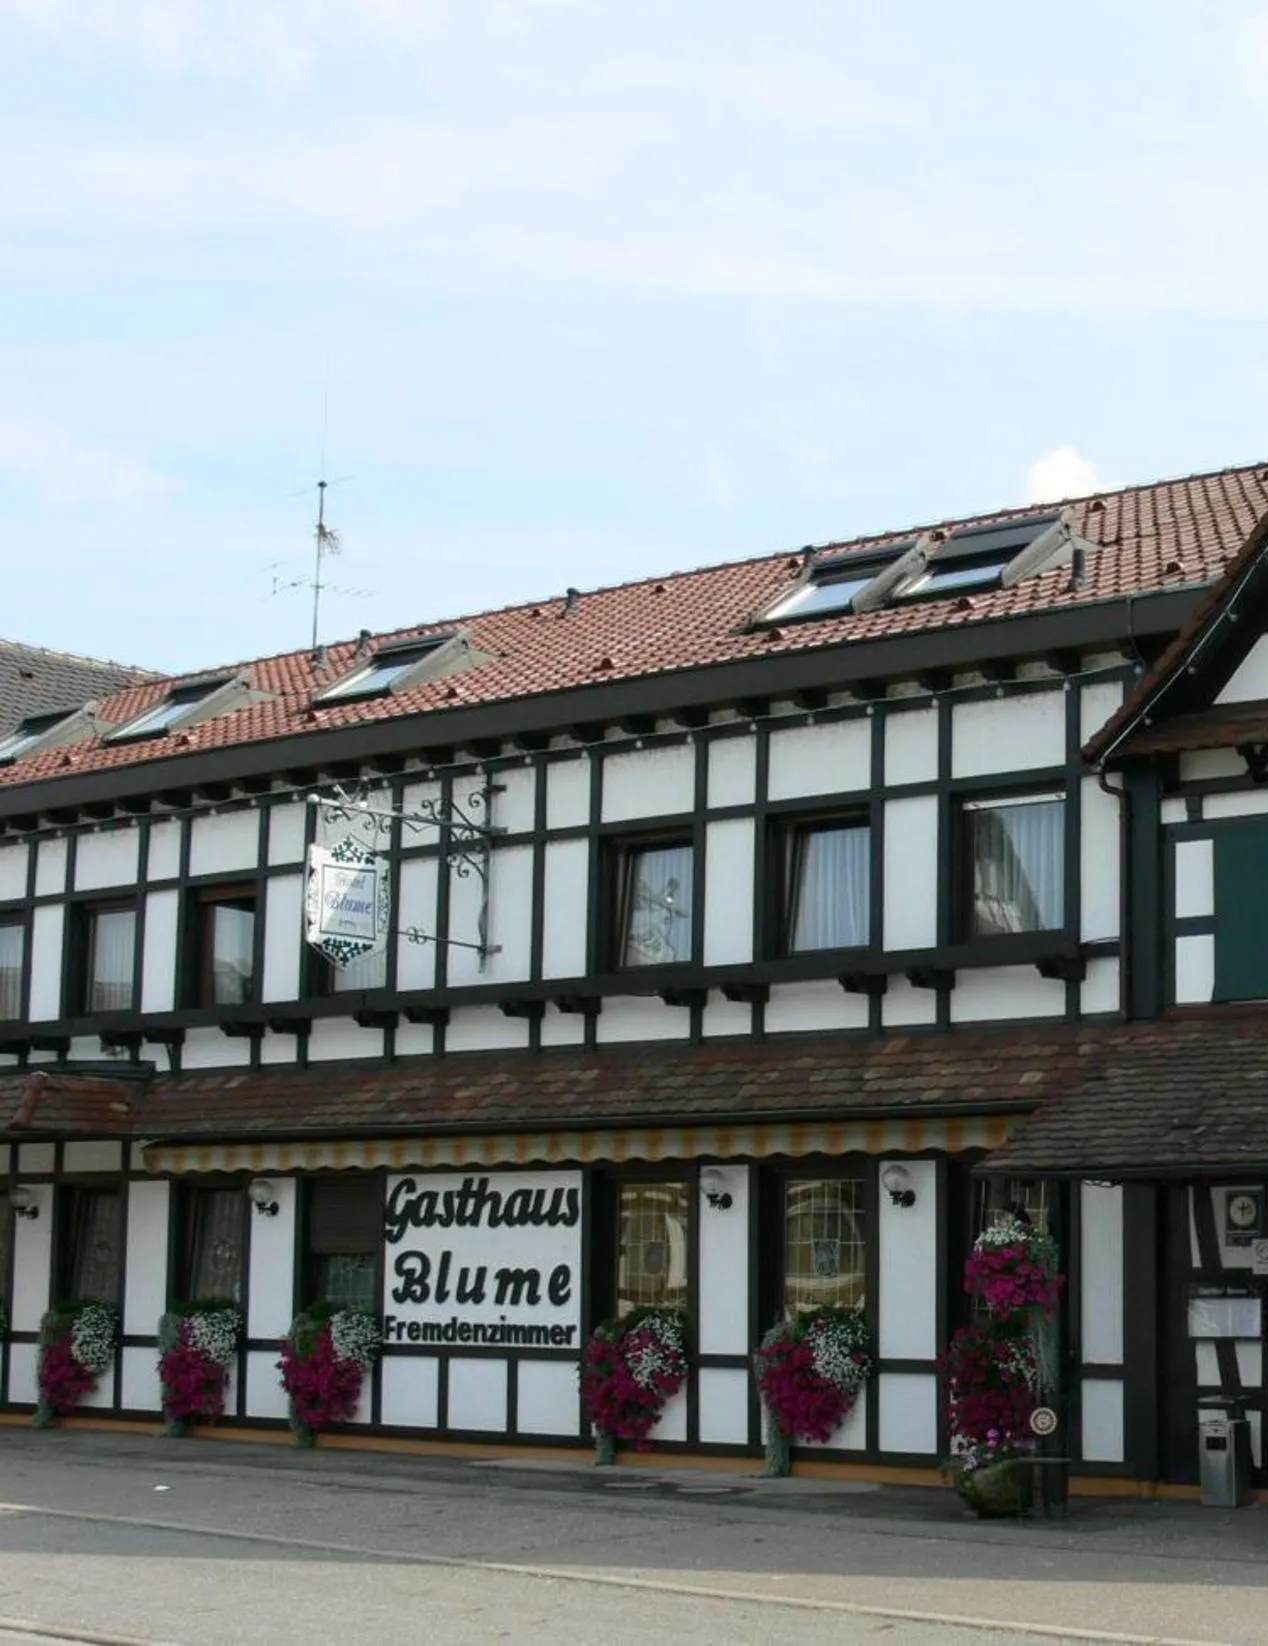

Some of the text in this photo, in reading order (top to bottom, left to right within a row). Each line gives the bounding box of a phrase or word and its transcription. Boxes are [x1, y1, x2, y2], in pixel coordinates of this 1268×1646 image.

[384, 1177, 579, 1243] Gasthaus
[391, 1250, 571, 1306] Blume
[384, 1315, 577, 1345] Fremdenzimmer
